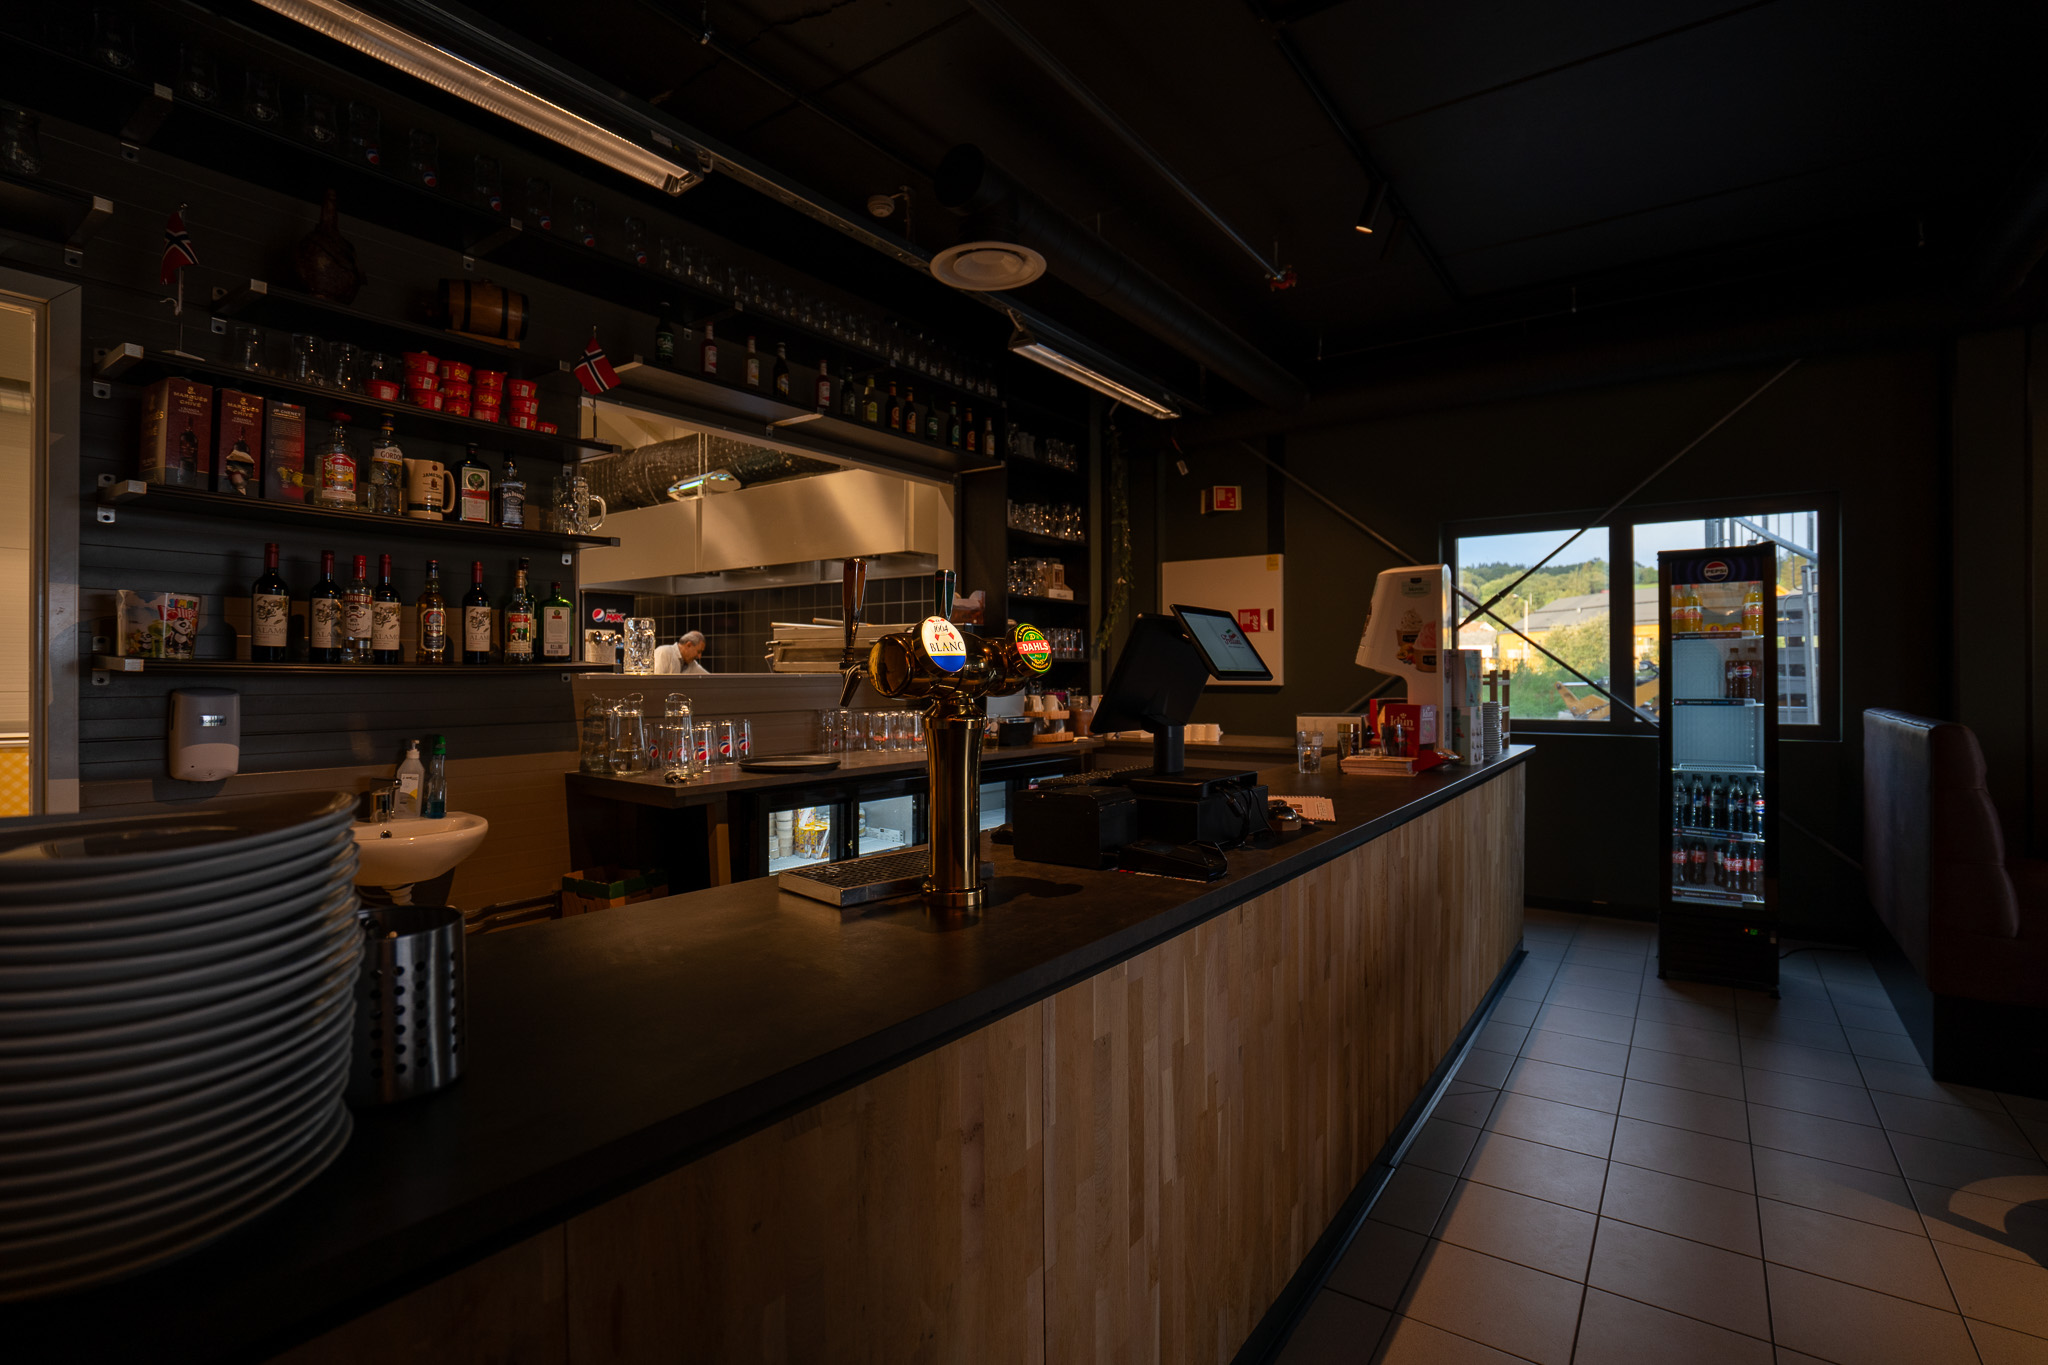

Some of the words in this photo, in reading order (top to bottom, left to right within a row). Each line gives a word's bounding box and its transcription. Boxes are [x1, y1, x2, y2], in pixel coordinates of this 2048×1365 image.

[325, 462, 355, 473] SIERRA
[1705, 567, 1729, 575] PEPSI
[604, 612, 626, 623] MAX
[929, 641, 965, 652] BLANC
[1022, 642, 1049, 652] DAHLS
[1390, 714, 1415, 727] Idun
